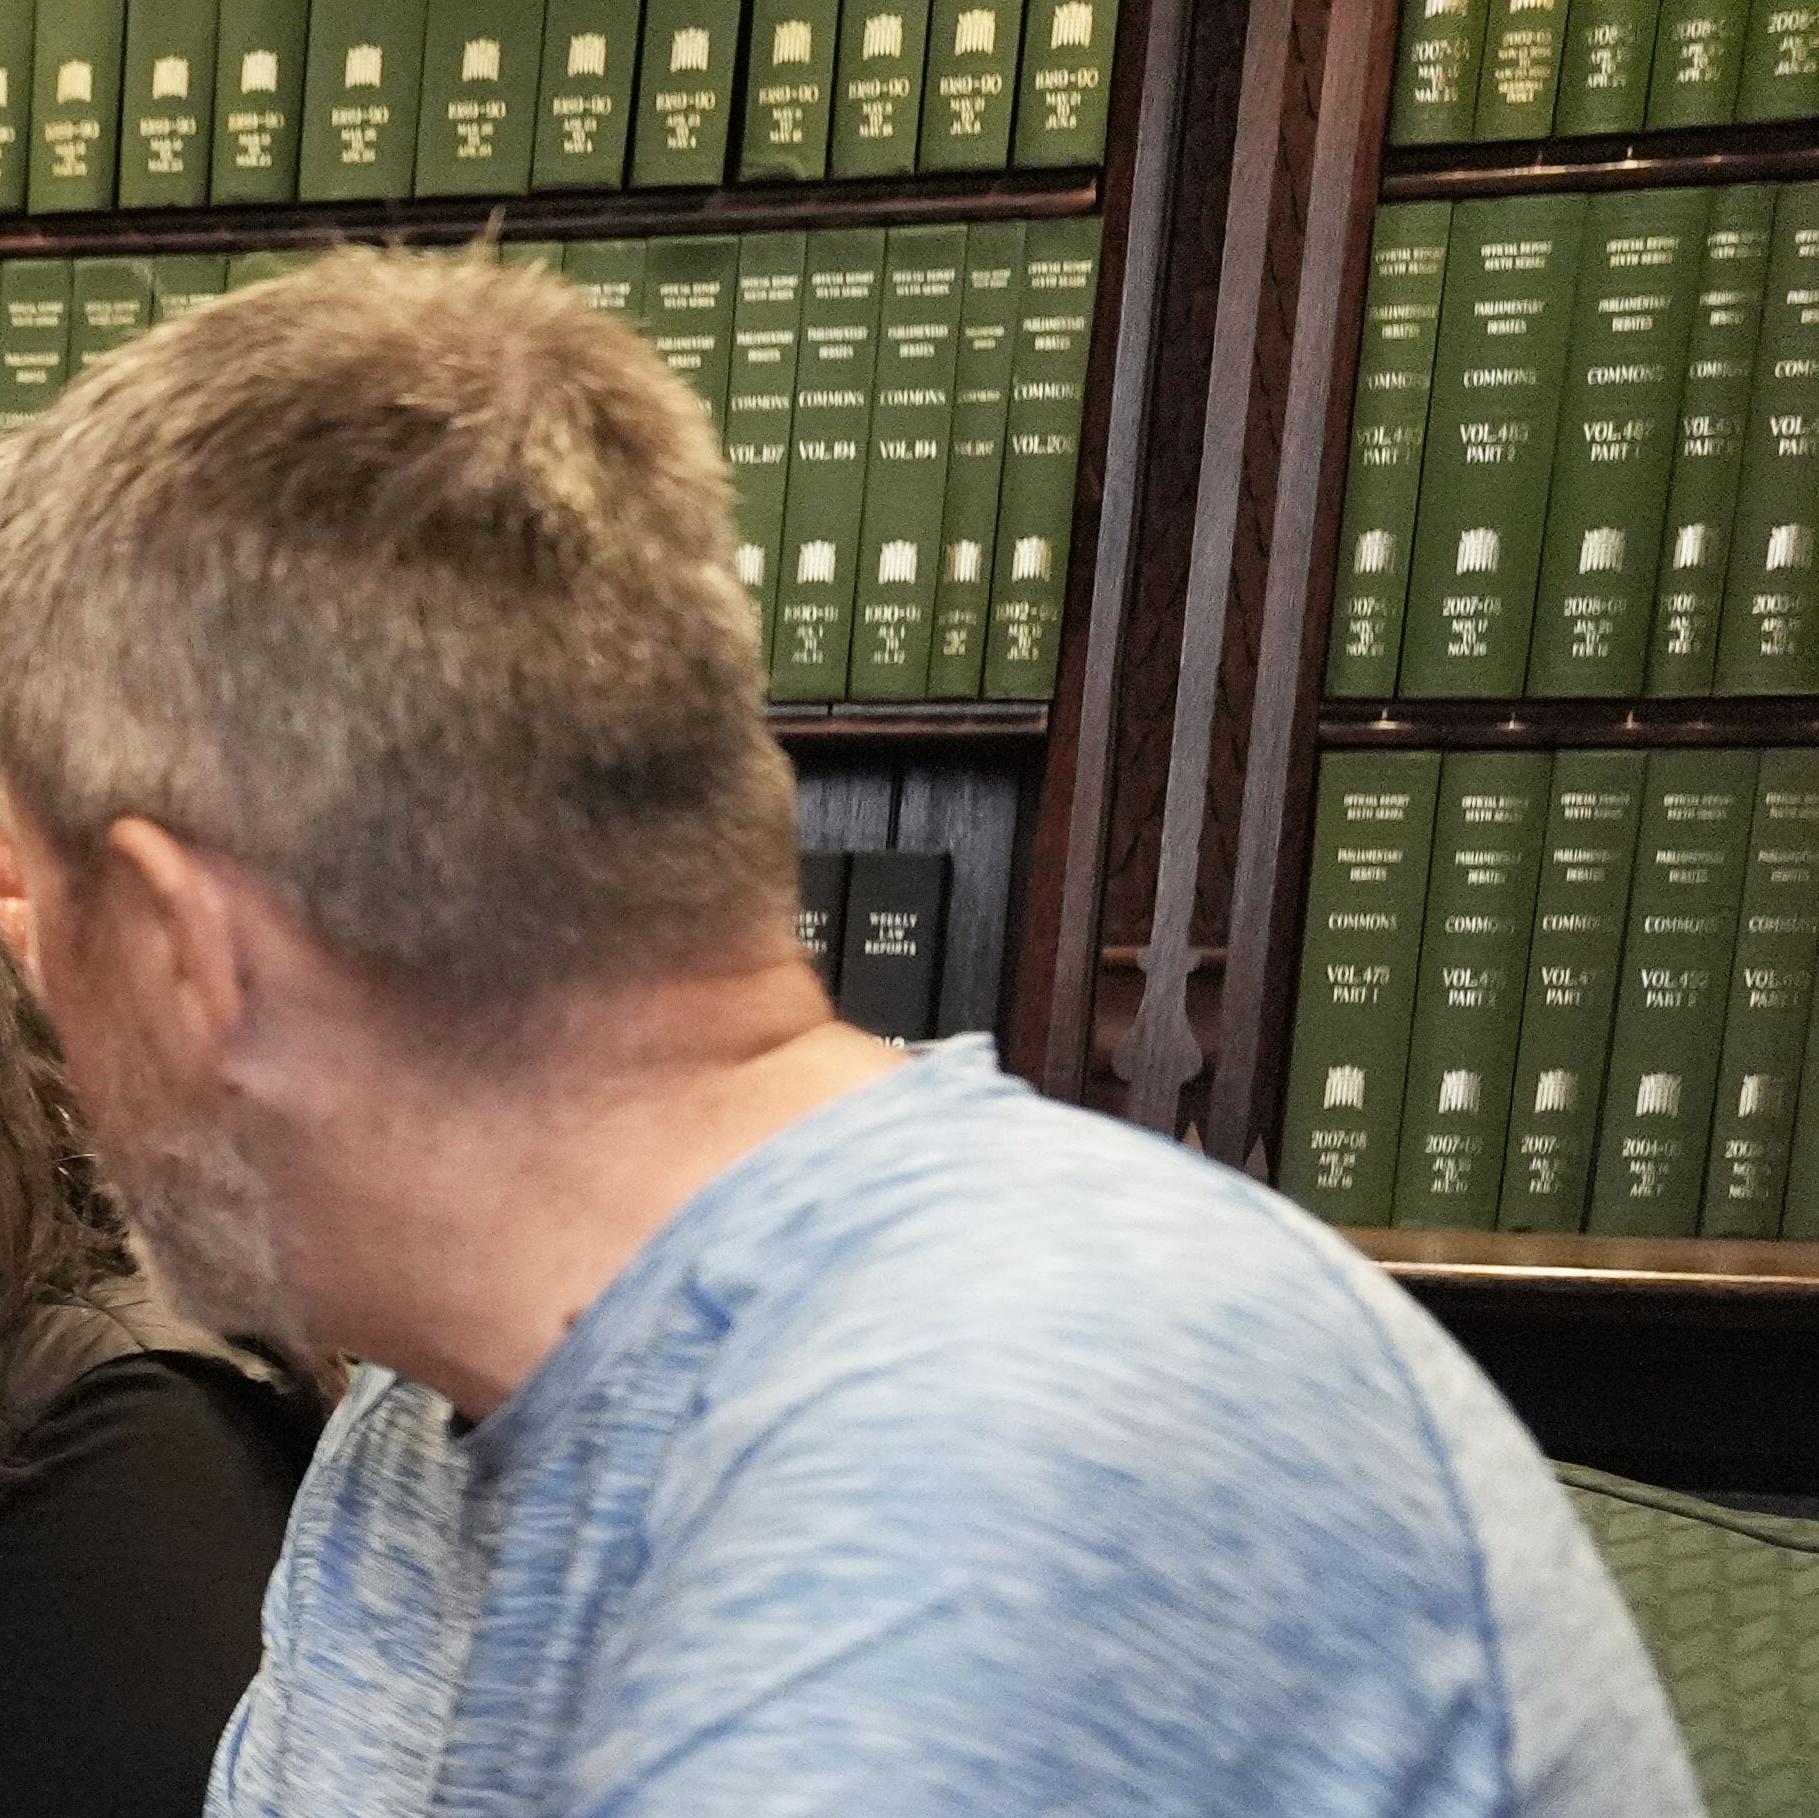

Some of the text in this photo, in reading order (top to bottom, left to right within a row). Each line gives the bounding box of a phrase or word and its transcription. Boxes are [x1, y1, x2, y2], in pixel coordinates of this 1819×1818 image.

[1463, 367, 1537, 389] COMMONS
[799, 389, 864, 408] COMMONS
[879, 388, 945, 406] COMMONS
[1466, 445, 1503, 465] PART
[1590, 442, 1629, 462] PART
[869, 911, 917, 928] WEEKLY
[1328, 912, 1398, 932] COMMONS
[879, 926, 904, 941] LAW
[865, 940, 917, 956] REPORTS
[1333, 986, 1367, 1004] PART
[1448, 988, 1483, 1007] PART
[1546, 987, 1582, 1006] PART
[1646, 989, 1682, 1008] PART
